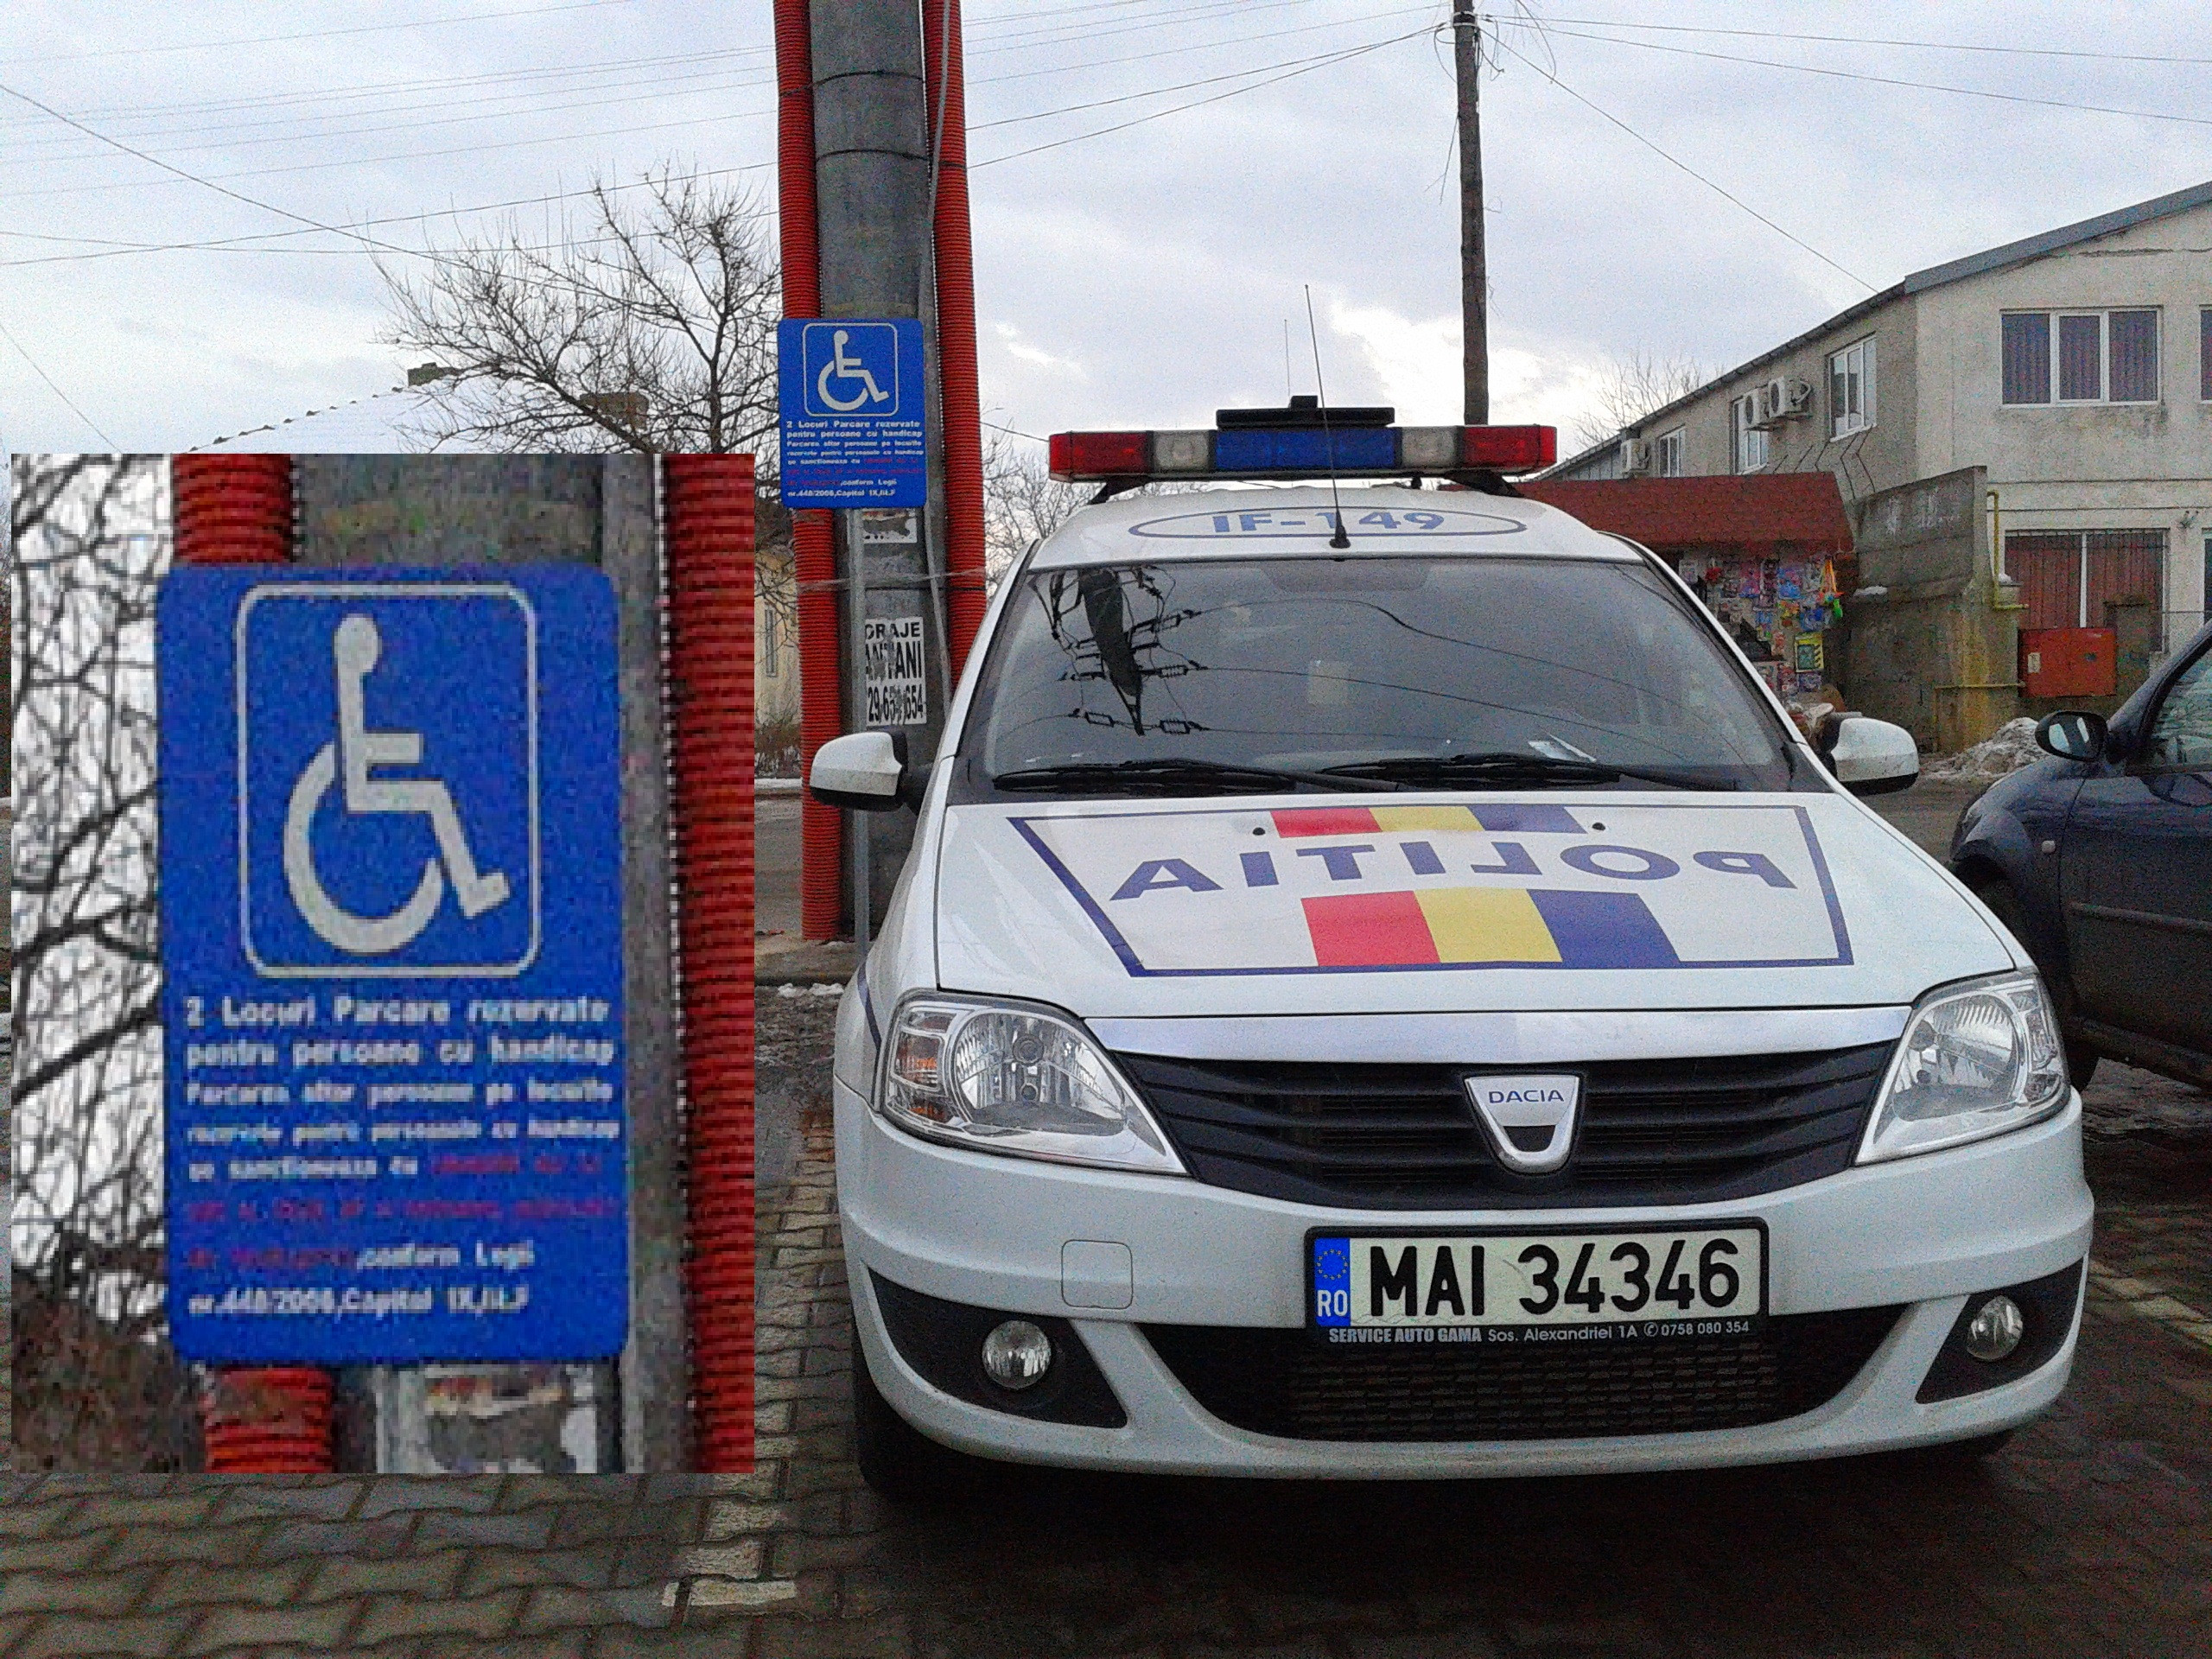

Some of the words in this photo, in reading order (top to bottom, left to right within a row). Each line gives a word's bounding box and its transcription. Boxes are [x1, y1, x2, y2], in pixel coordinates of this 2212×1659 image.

[798, 420, 829, 429] Locuri
[833, 420, 871, 429] Parcare
[882, 429, 923, 438] handicap
[1212, 512, 1445, 532] IF-149
[334, 994, 453, 1027] Parcare
[1488, 1089, 1565, 1104] DACIA
[1370, 1244, 1485, 1317] MAI
[1517, 1238, 1740, 1316] 34346
[1316, 1289, 1348, 1318] RO
[1328, 1327, 1392, 1344] SERVICE
[1394, 1327, 1435, 1344] AUTO
[1437, 1327, 1483, 1343] GAMA
[1487, 1328, 1519, 1343] Sos.
[1618, 1324, 1638, 1339] 1A
[1661, 1322, 1694, 1337] 0758
[1697, 1322, 1722, 1335] 080
[1726, 1320, 1750, 1334] 354
